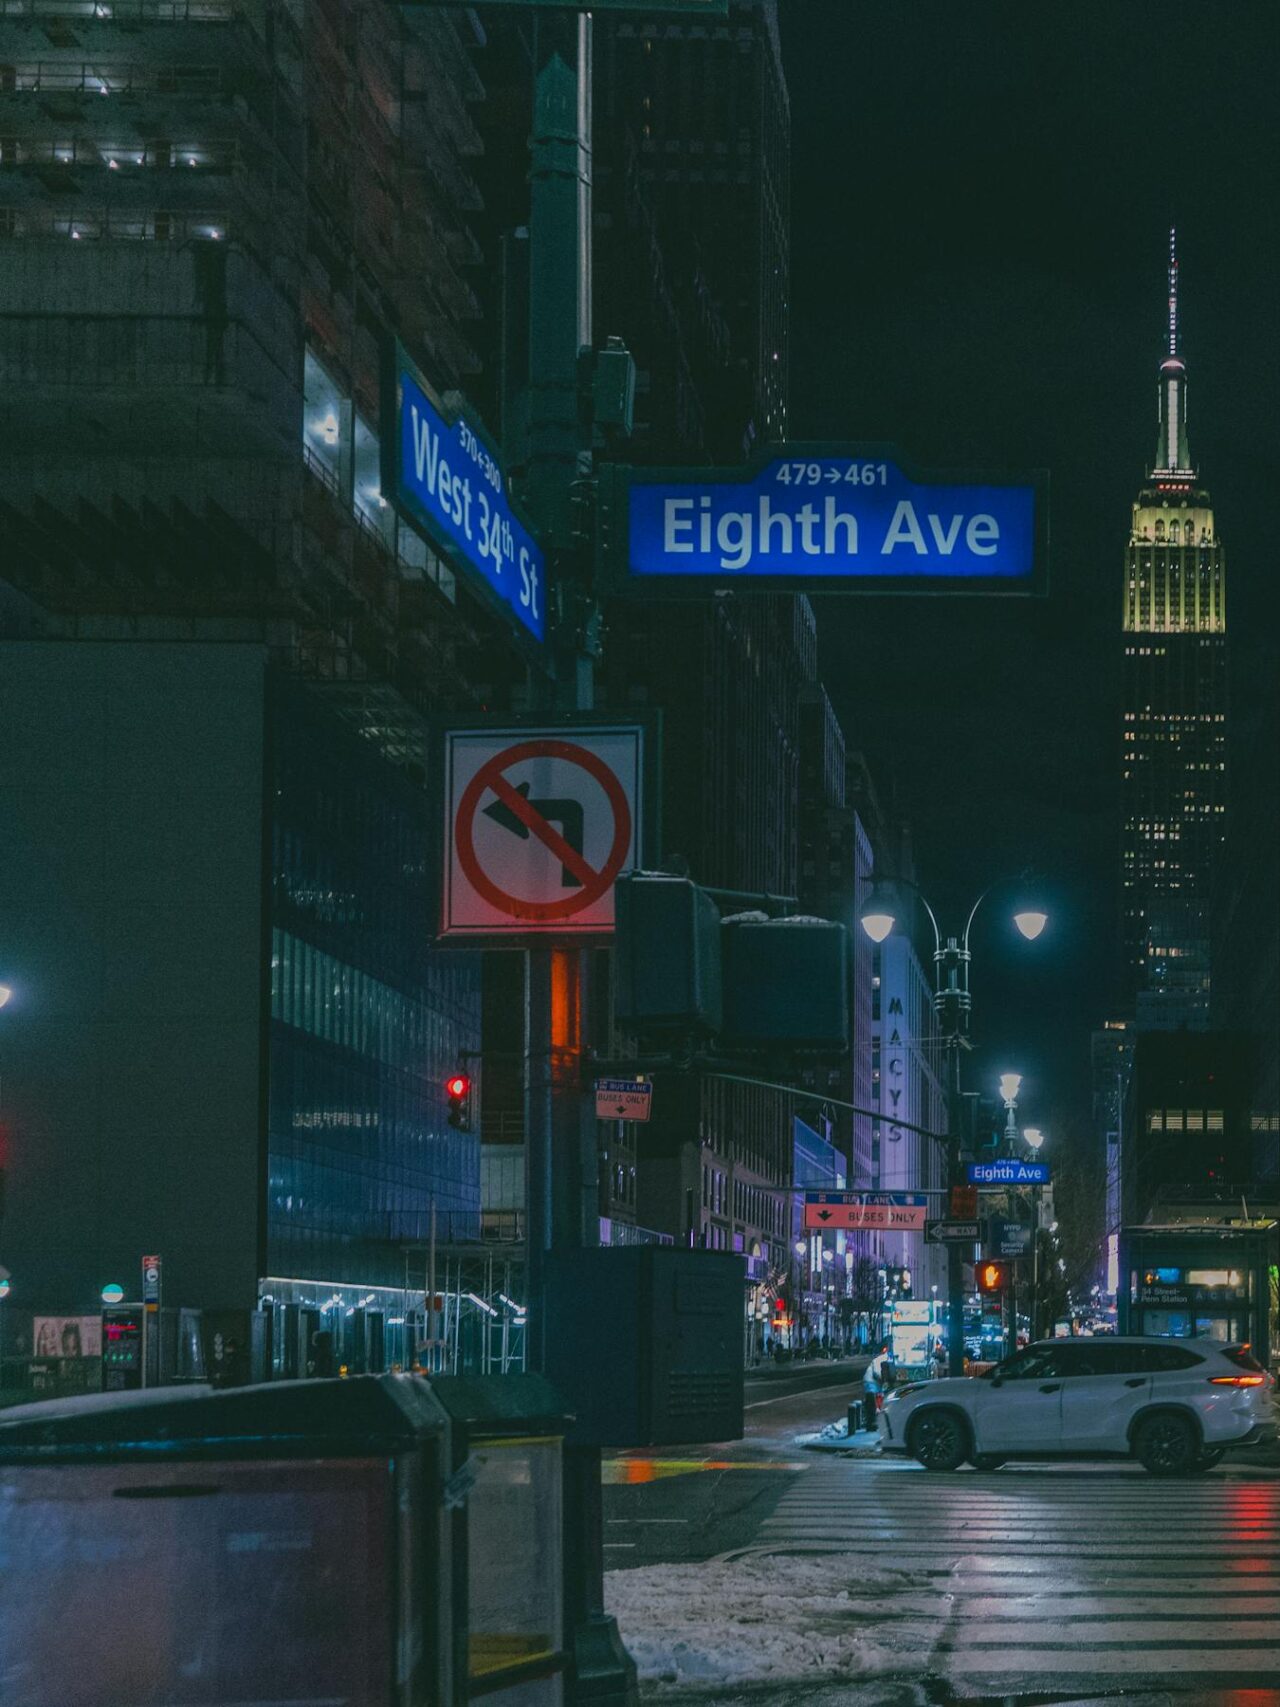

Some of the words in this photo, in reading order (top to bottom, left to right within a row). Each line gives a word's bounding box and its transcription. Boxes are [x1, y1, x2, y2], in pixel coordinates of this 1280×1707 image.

[459, 420, 478, 463] 370
[483, 453, 501, 494] 300
[775, 463, 821, 487] 479
[844, 463, 888, 487] 461
[411, 404, 473, 541] West
[478, 491, 514, 575] 34th
[519, 546, 539, 620] St
[663, 496, 859, 570] Eighth
[880, 500, 1001, 557] Ave
[888, 997, 904, 1143] MACY'S
[609, 1082, 625, 1092] BUS
[627, 1083, 647, 1093] LANE
[598, 1092, 623, 1103] BUSES
[626, 1095, 647, 1105] ONLY
[973, 1166, 1015, 1183] Eighth
[1016, 1166, 1042, 1180] Ave
[842, 1195, 860, 1204] BUS
[867, 1195, 890, 1205] LANE
[848, 1212, 884, 1222] BUSES
[957, 1226, 973, 1234] WAY
[1003, 1223, 1022, 1231] NYPD
[1141, 1295, 1160, 1304] Penn
[1161, 1295, 1188, 1304] Station
[1195, 1291, 1203, 1301] A
[1210, 1291, 1218, 1301] C
